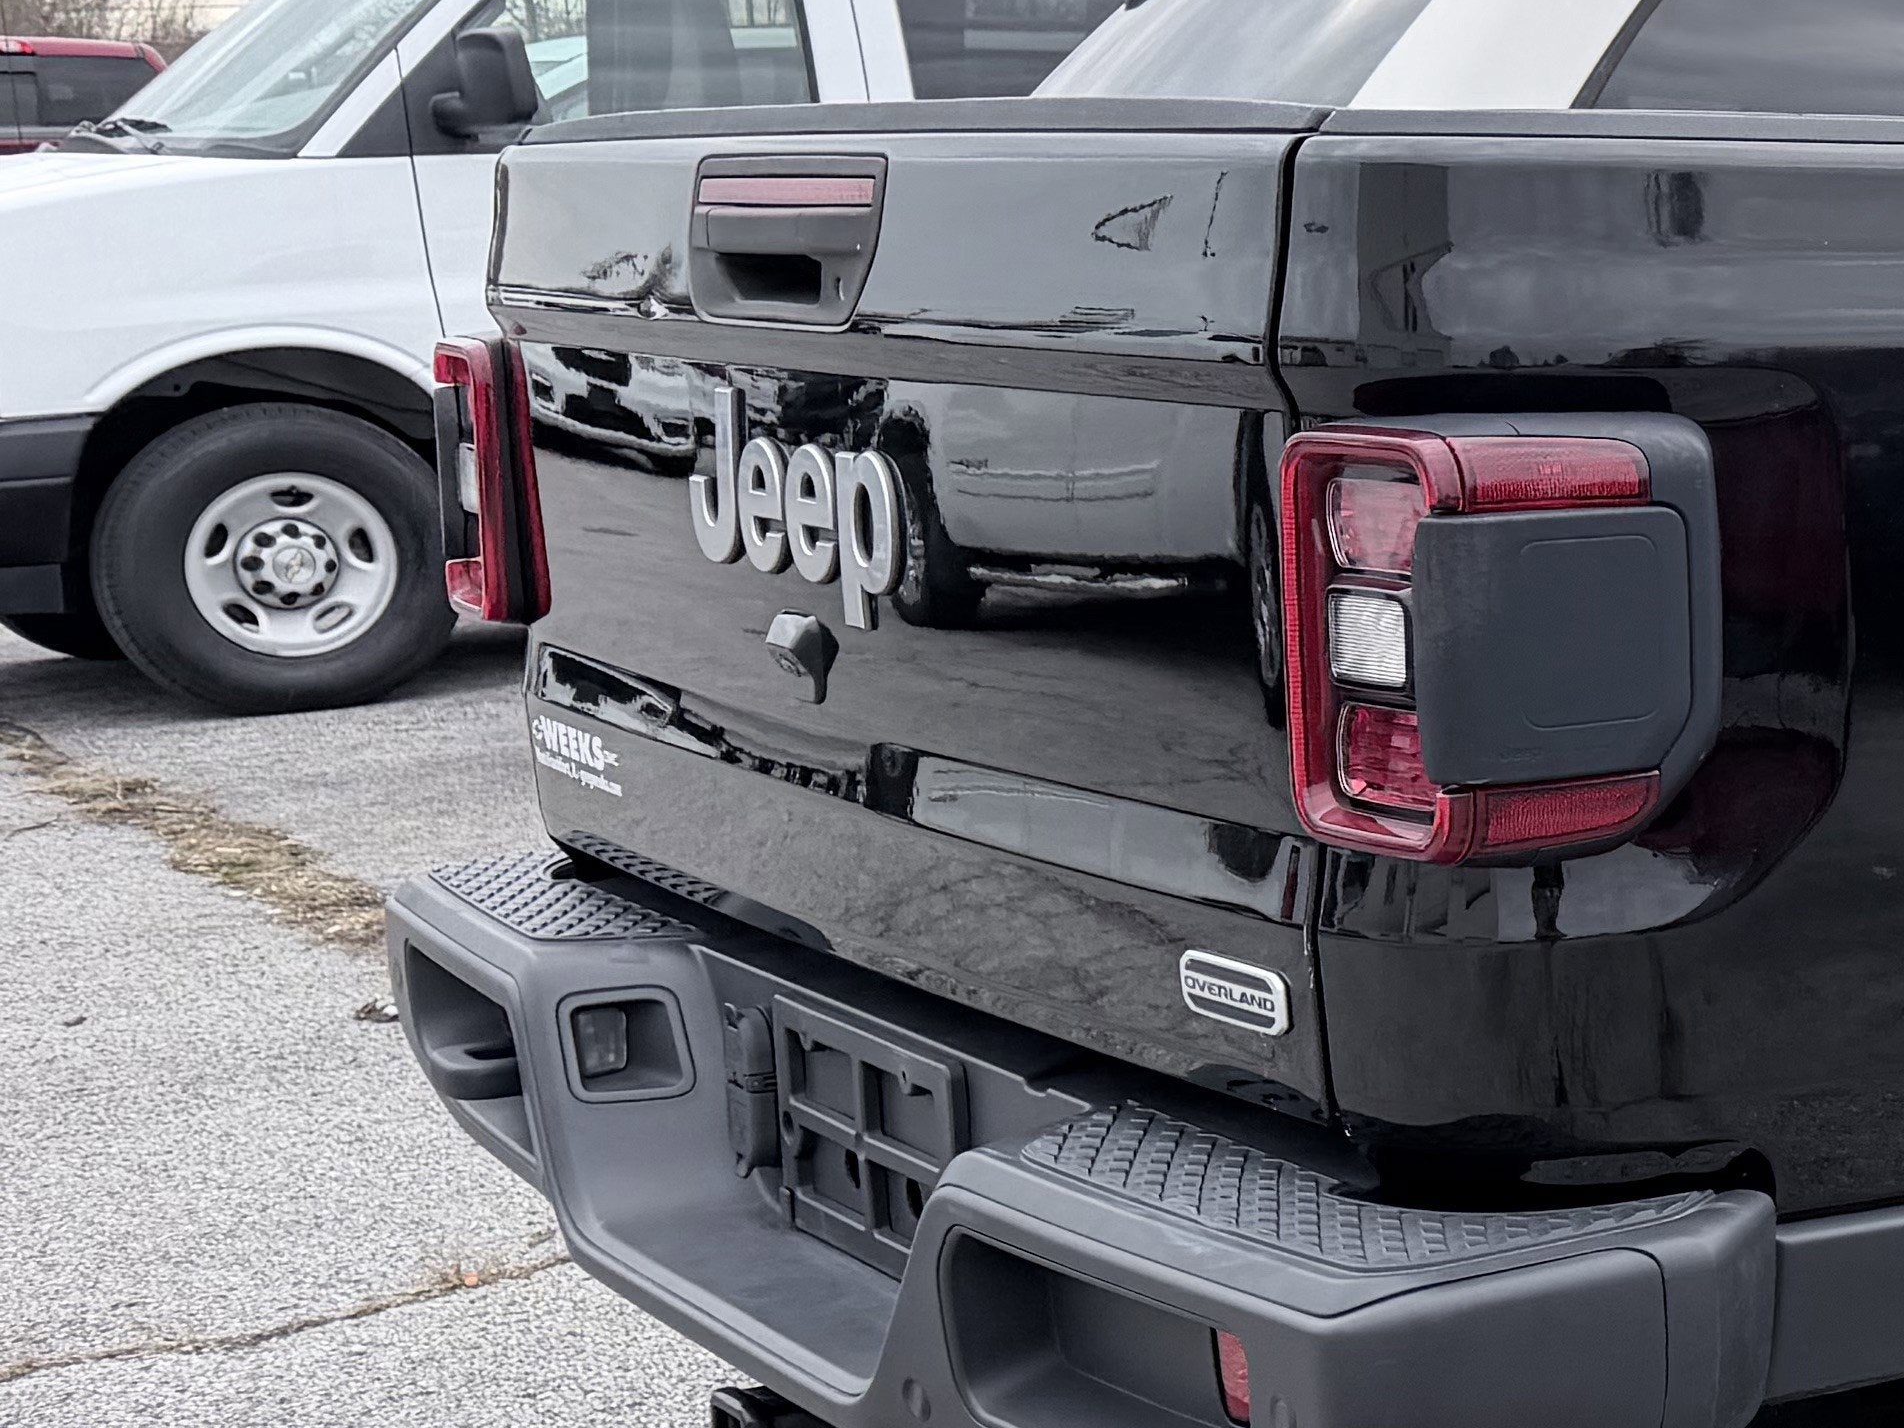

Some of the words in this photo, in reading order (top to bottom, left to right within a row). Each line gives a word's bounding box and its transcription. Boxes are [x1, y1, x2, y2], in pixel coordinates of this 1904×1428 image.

[689, 386, 906, 631] Jeep
[539, 714, 605, 771] WEEKS
[1184, 975, 1275, 1012] OVERLAND
